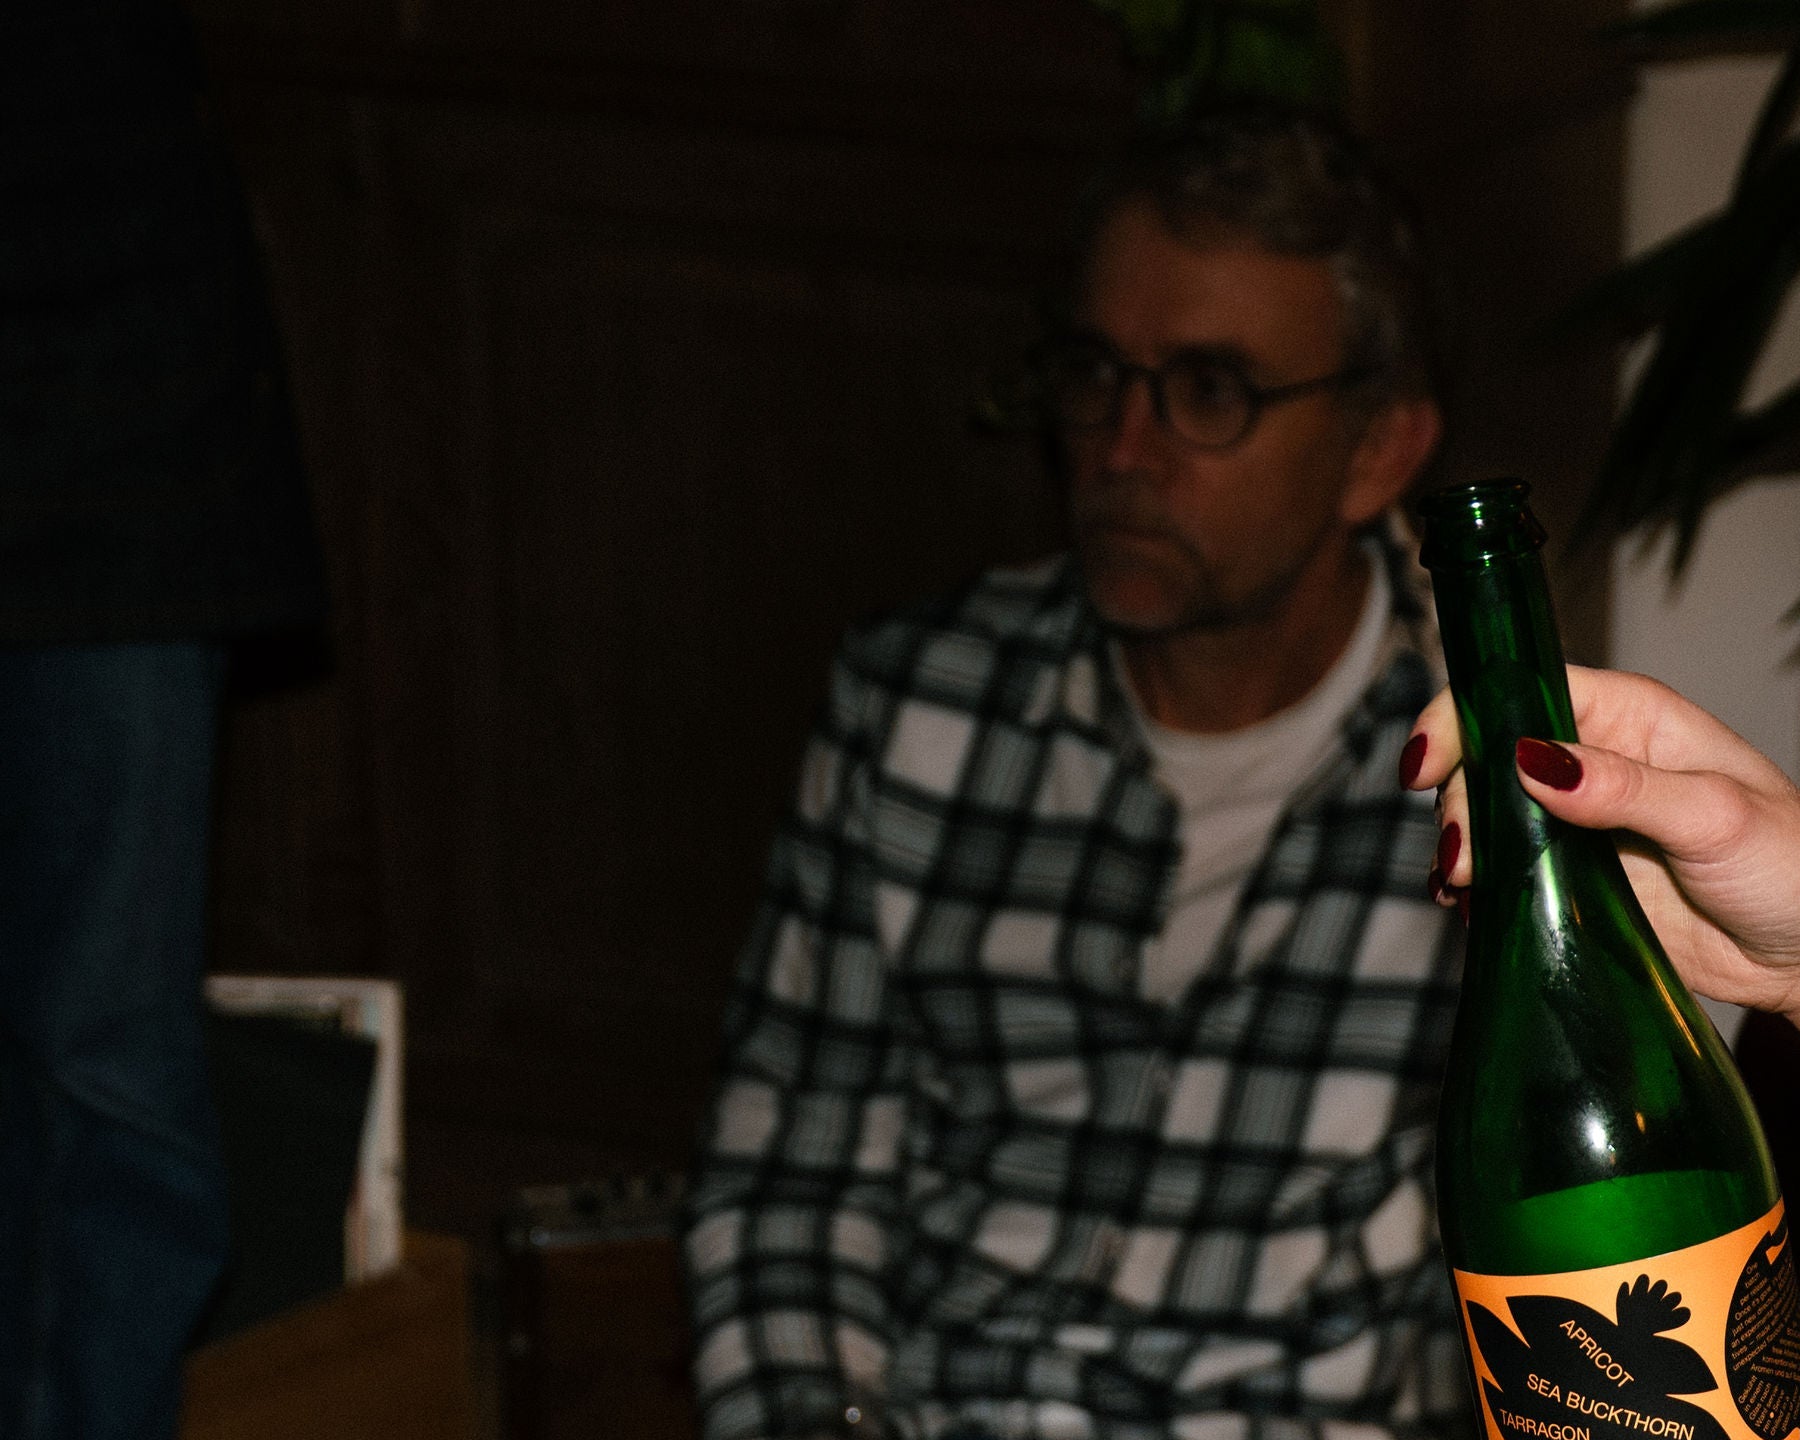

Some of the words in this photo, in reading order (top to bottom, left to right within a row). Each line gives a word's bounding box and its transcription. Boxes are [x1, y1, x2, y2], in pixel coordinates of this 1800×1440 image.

[1735, 1305, 1751, 1320] Once
[1560, 1319, 1635, 1388] APRICOT
[1733, 1340, 1767, 1370] unexpected
[1527, 1373, 1561, 1403] SEA
[1749, 1403, 1762, 1420] Glas
